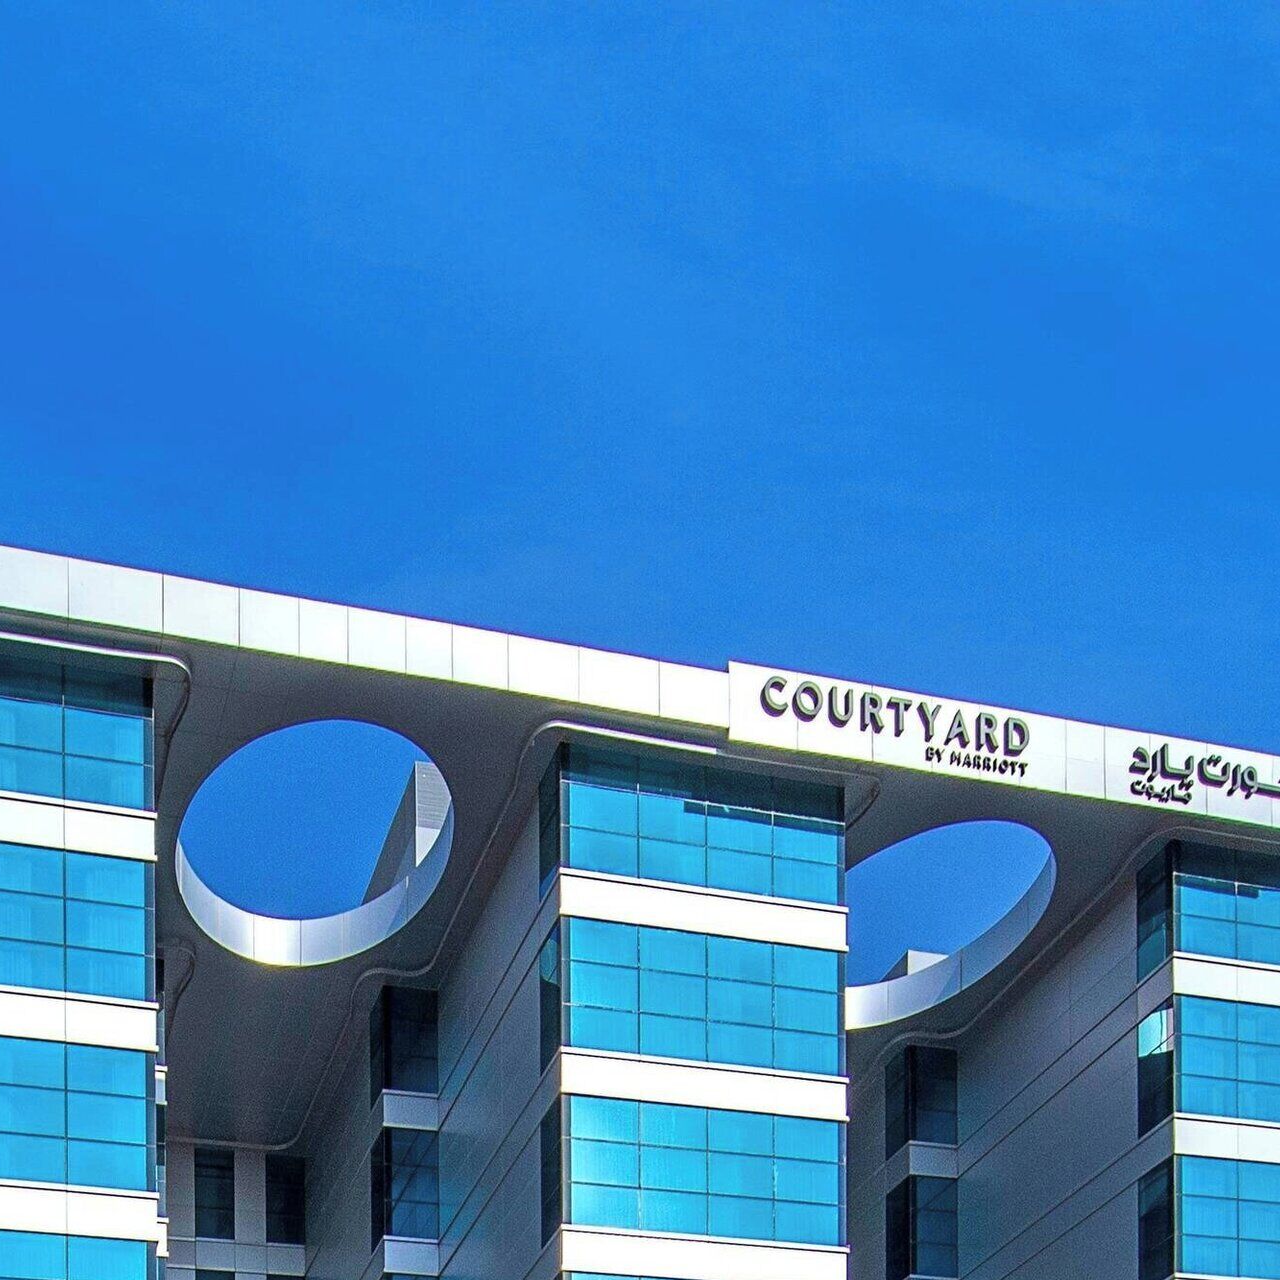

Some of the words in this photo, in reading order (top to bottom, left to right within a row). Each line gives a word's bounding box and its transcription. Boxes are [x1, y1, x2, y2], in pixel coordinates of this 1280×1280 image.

[760, 676, 1030, 757] COURTYARD
[925, 746, 945, 763] BY
[950, 752, 1029, 777] MARRIOTT
[1129, 743, 1194, 791] يارد
[1130, 780, 1192, 805] ماريوت
